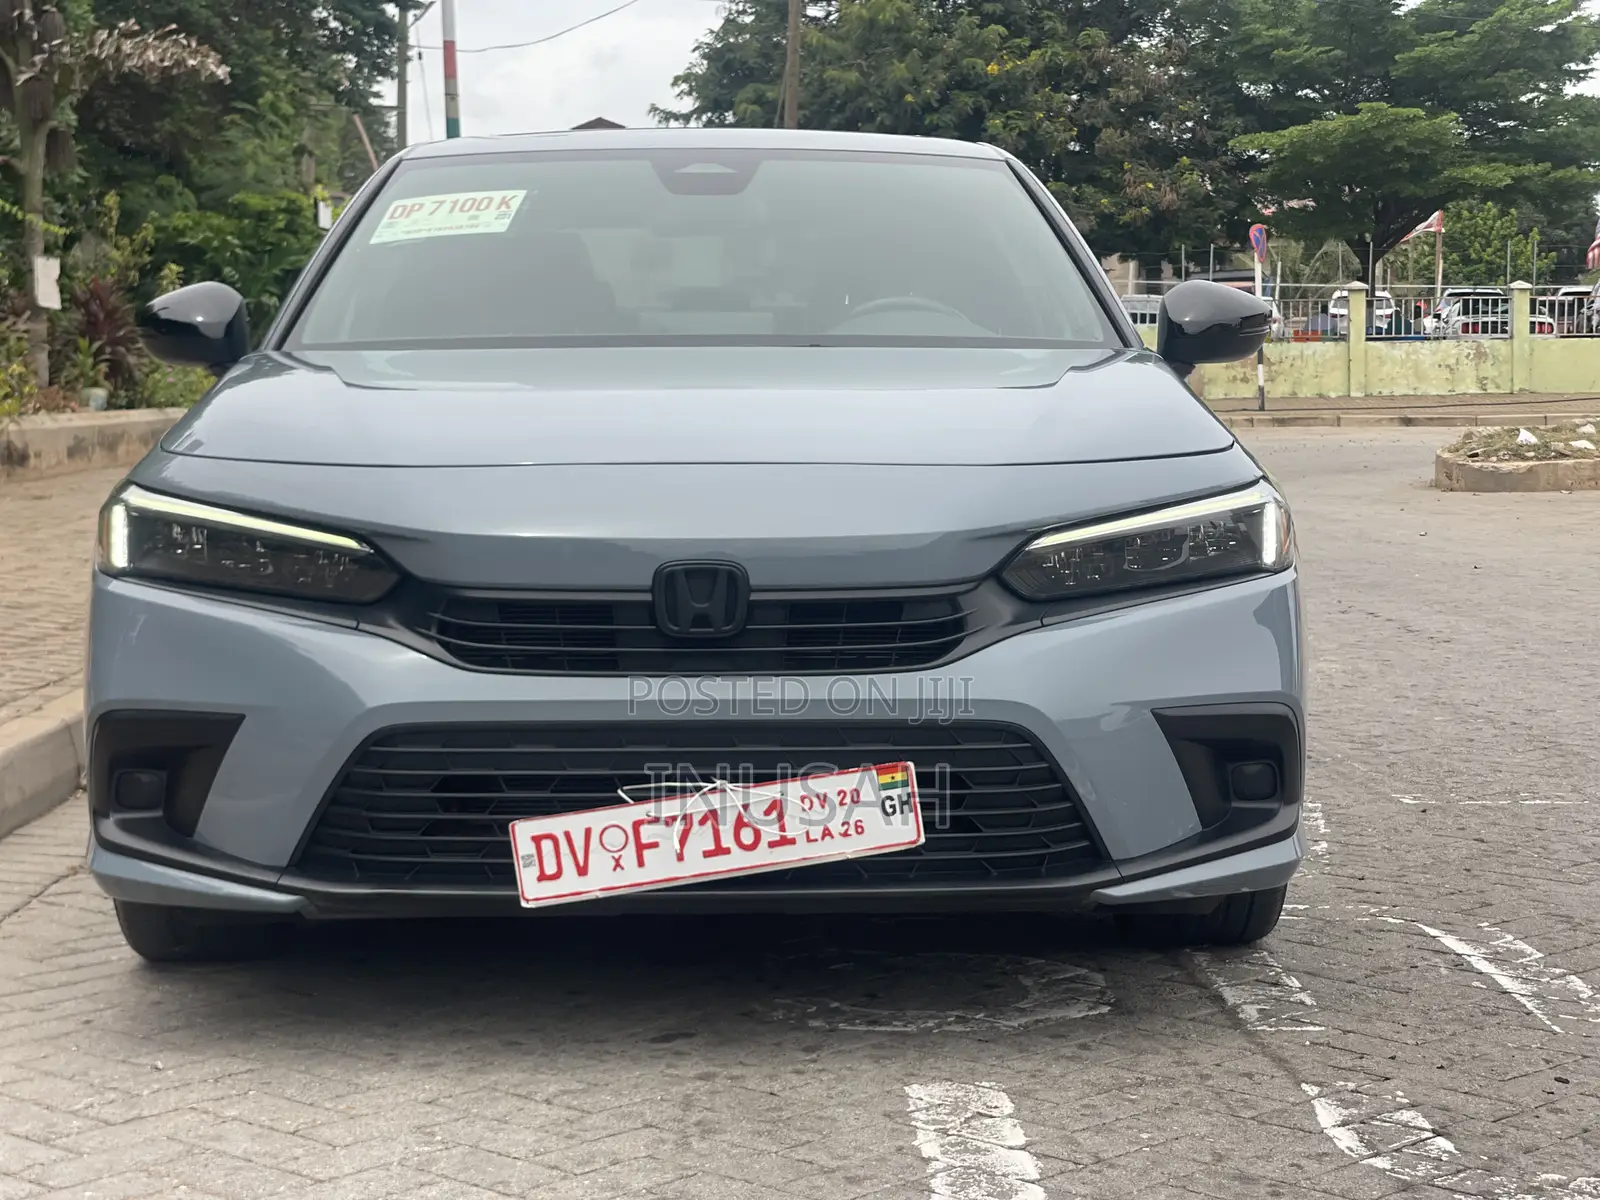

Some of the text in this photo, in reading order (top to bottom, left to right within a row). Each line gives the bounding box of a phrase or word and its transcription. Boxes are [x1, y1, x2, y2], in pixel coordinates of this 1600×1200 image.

[387, 202, 425, 221] DP
[428, 196, 495, 217] 7100
[496, 194, 518, 211] K
[837, 788, 861, 807] 20
[880, 791, 914, 817] GH
[805, 819, 865, 843] LA 26
[530, 826, 592, 883] DV
